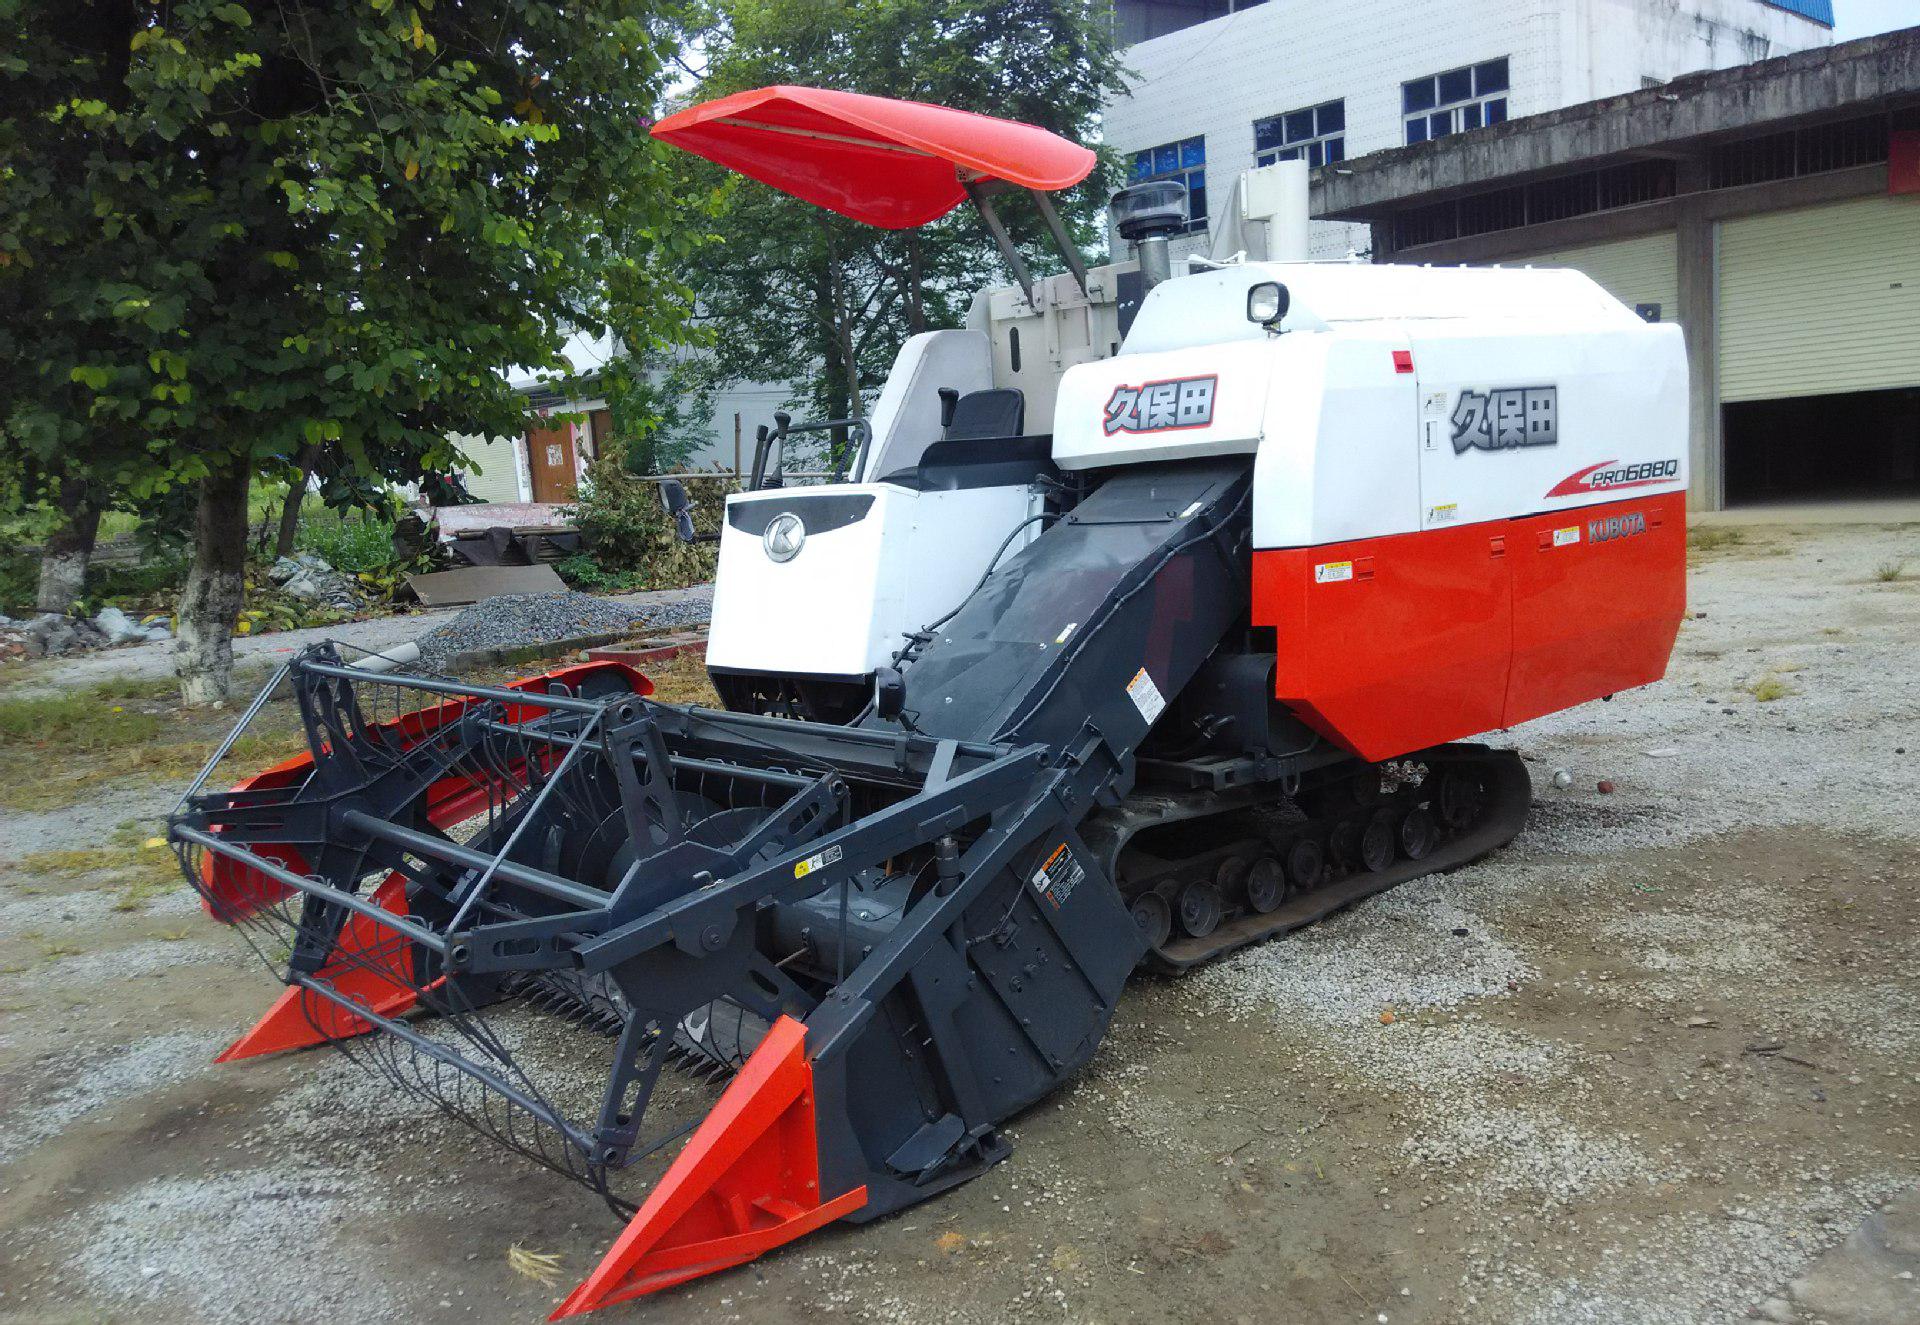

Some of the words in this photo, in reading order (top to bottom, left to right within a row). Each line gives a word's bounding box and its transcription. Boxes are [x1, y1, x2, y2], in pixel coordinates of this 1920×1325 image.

[1104, 376, 1217, 435] 久保田
[1451, 386, 1557, 455] 久保田
[1591, 459, 1678, 487] PRO688Q
[1588, 512, 1647, 544] KUBOTA
